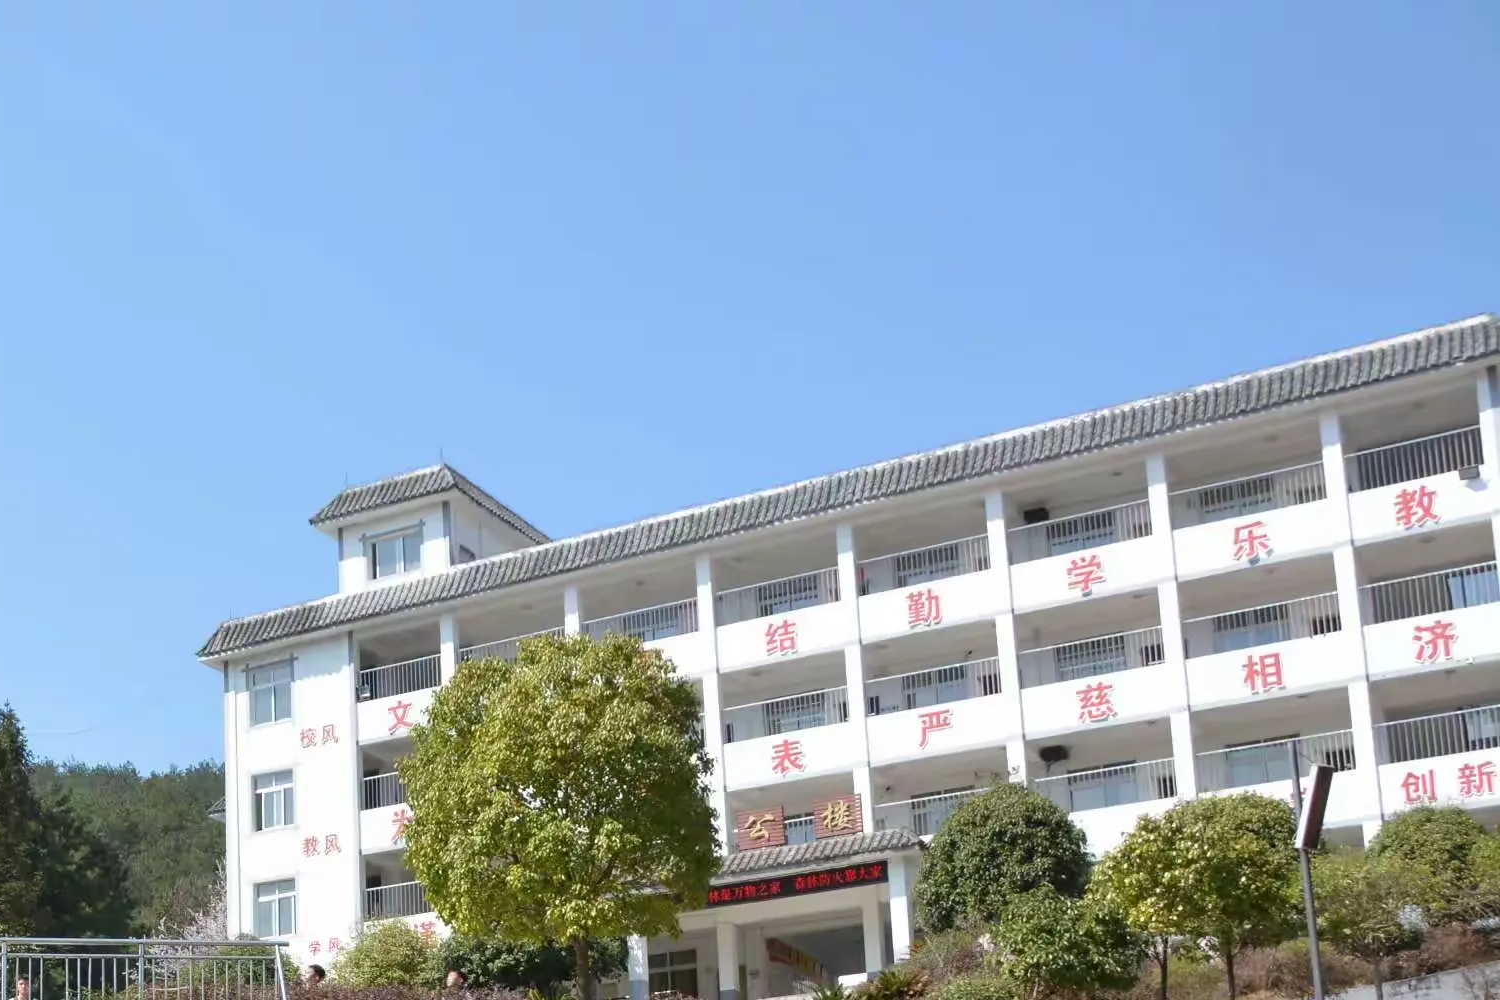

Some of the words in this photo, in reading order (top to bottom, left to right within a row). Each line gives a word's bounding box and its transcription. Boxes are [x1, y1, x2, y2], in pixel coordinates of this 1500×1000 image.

[1067, 555, 1106, 594] 学
[1233, 520, 1270, 562] 乐
[1395, 484, 1441, 528] 教
[918, 708, 954, 748] 严
[1242, 652, 1285, 694] 相
[1412, 620, 1459, 664] 济
[300, 724, 339, 748] 校风
[303, 833, 342, 857] 教风
[308, 937, 341, 956] 学风
